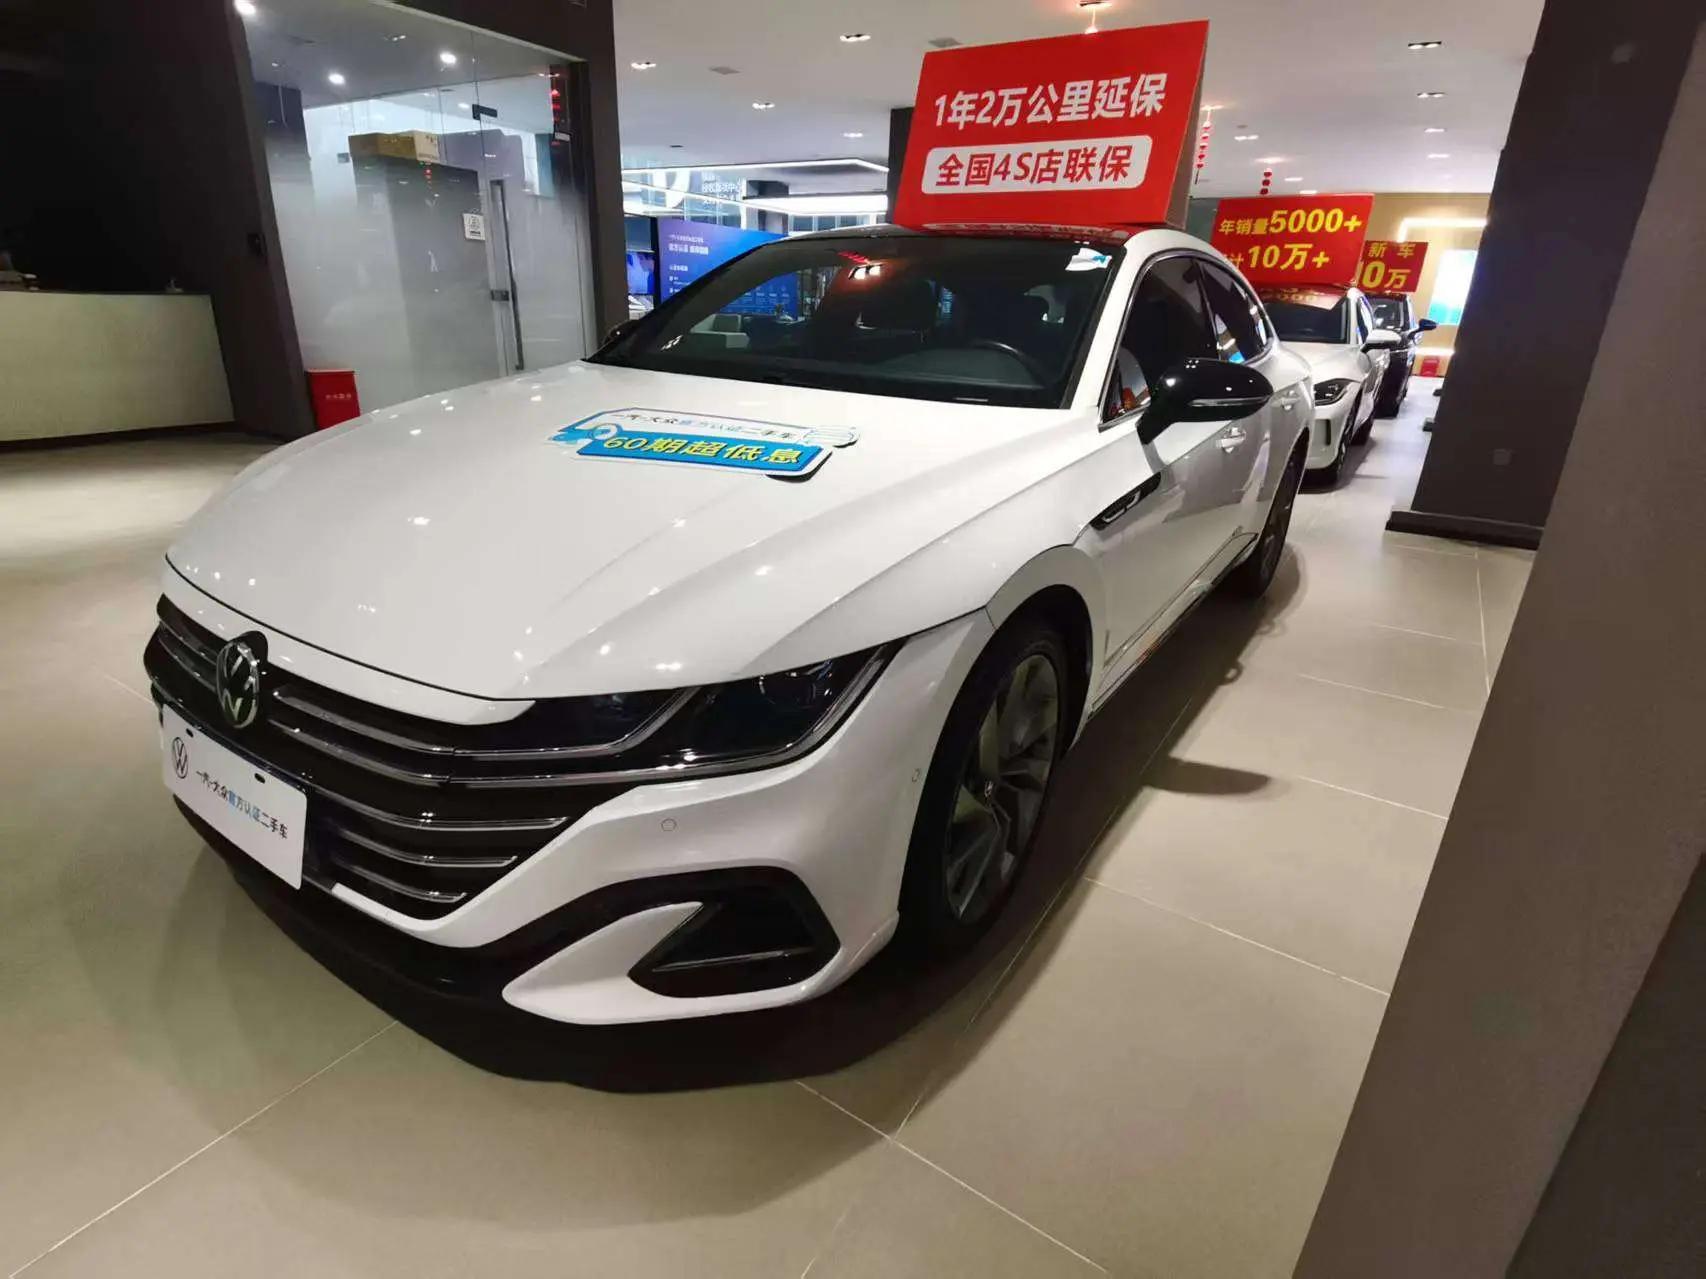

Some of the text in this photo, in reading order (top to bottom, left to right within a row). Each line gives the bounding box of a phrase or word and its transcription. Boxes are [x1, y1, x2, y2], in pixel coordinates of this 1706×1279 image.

[935, 73, 1168, 130] 1年2万公里延保
[935, 144, 1134, 187] 全国4S店联保
[1218, 207, 1362, 235] 年销量5000+
[1223, 243, 1330, 270] 计10万+
[1357, 260, 1412, 289] 0万
[603, 437, 801, 463] 60期超低息
